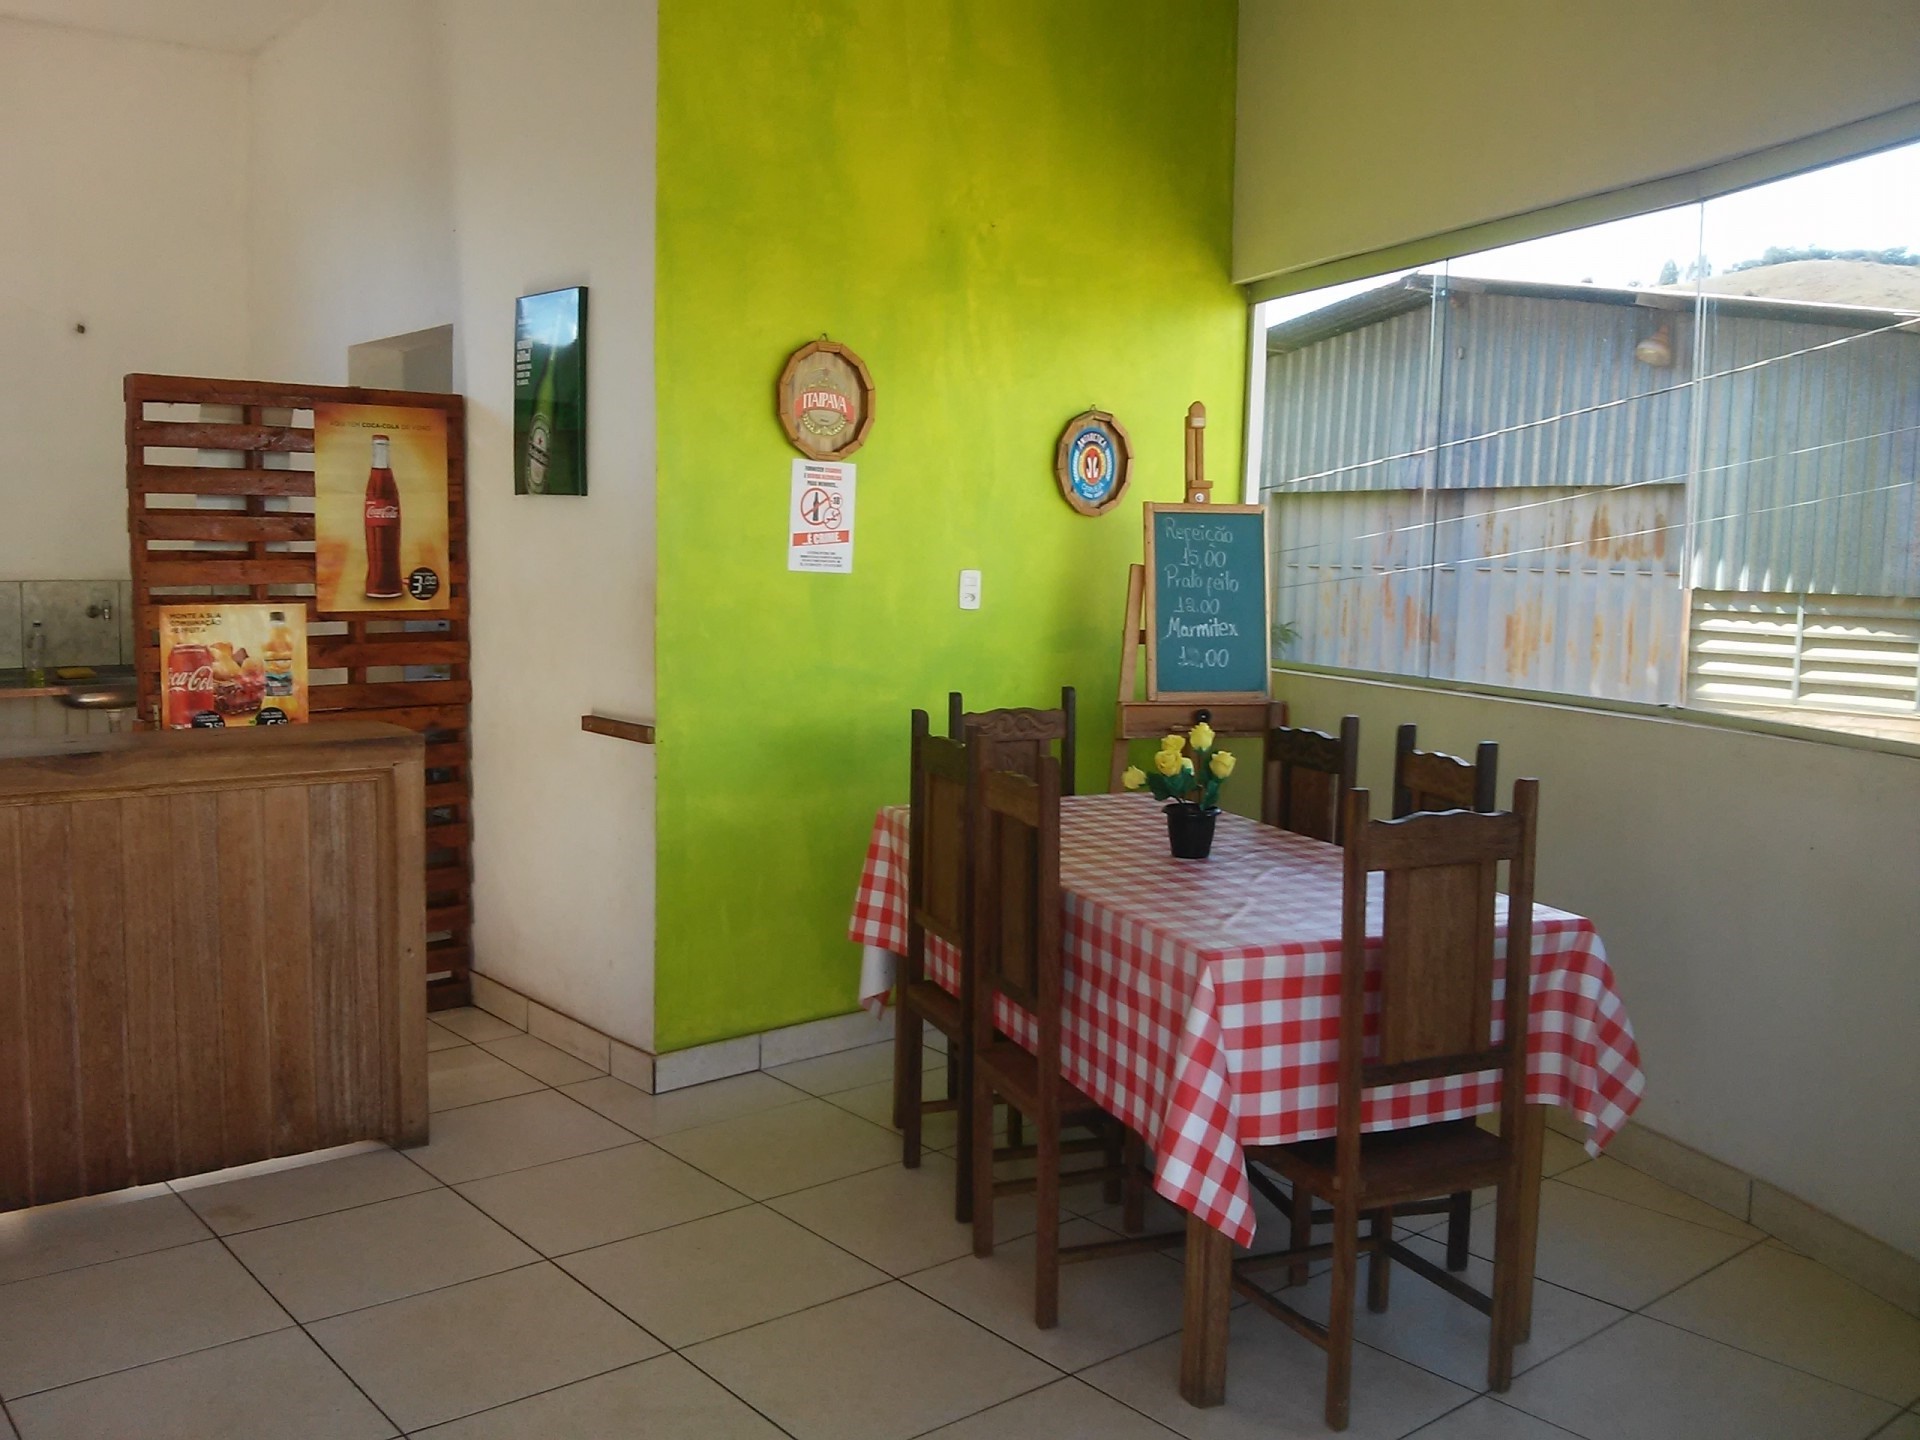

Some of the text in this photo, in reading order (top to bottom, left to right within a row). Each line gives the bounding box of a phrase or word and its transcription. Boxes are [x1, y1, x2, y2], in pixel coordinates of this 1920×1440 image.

[802, 392, 848, 413] ITAIPAVA
[361, 422, 400, 430] COCA-COLA
[1163, 563, 1239, 597] Prato feito
[1163, 617, 1239, 638] Marmitex
